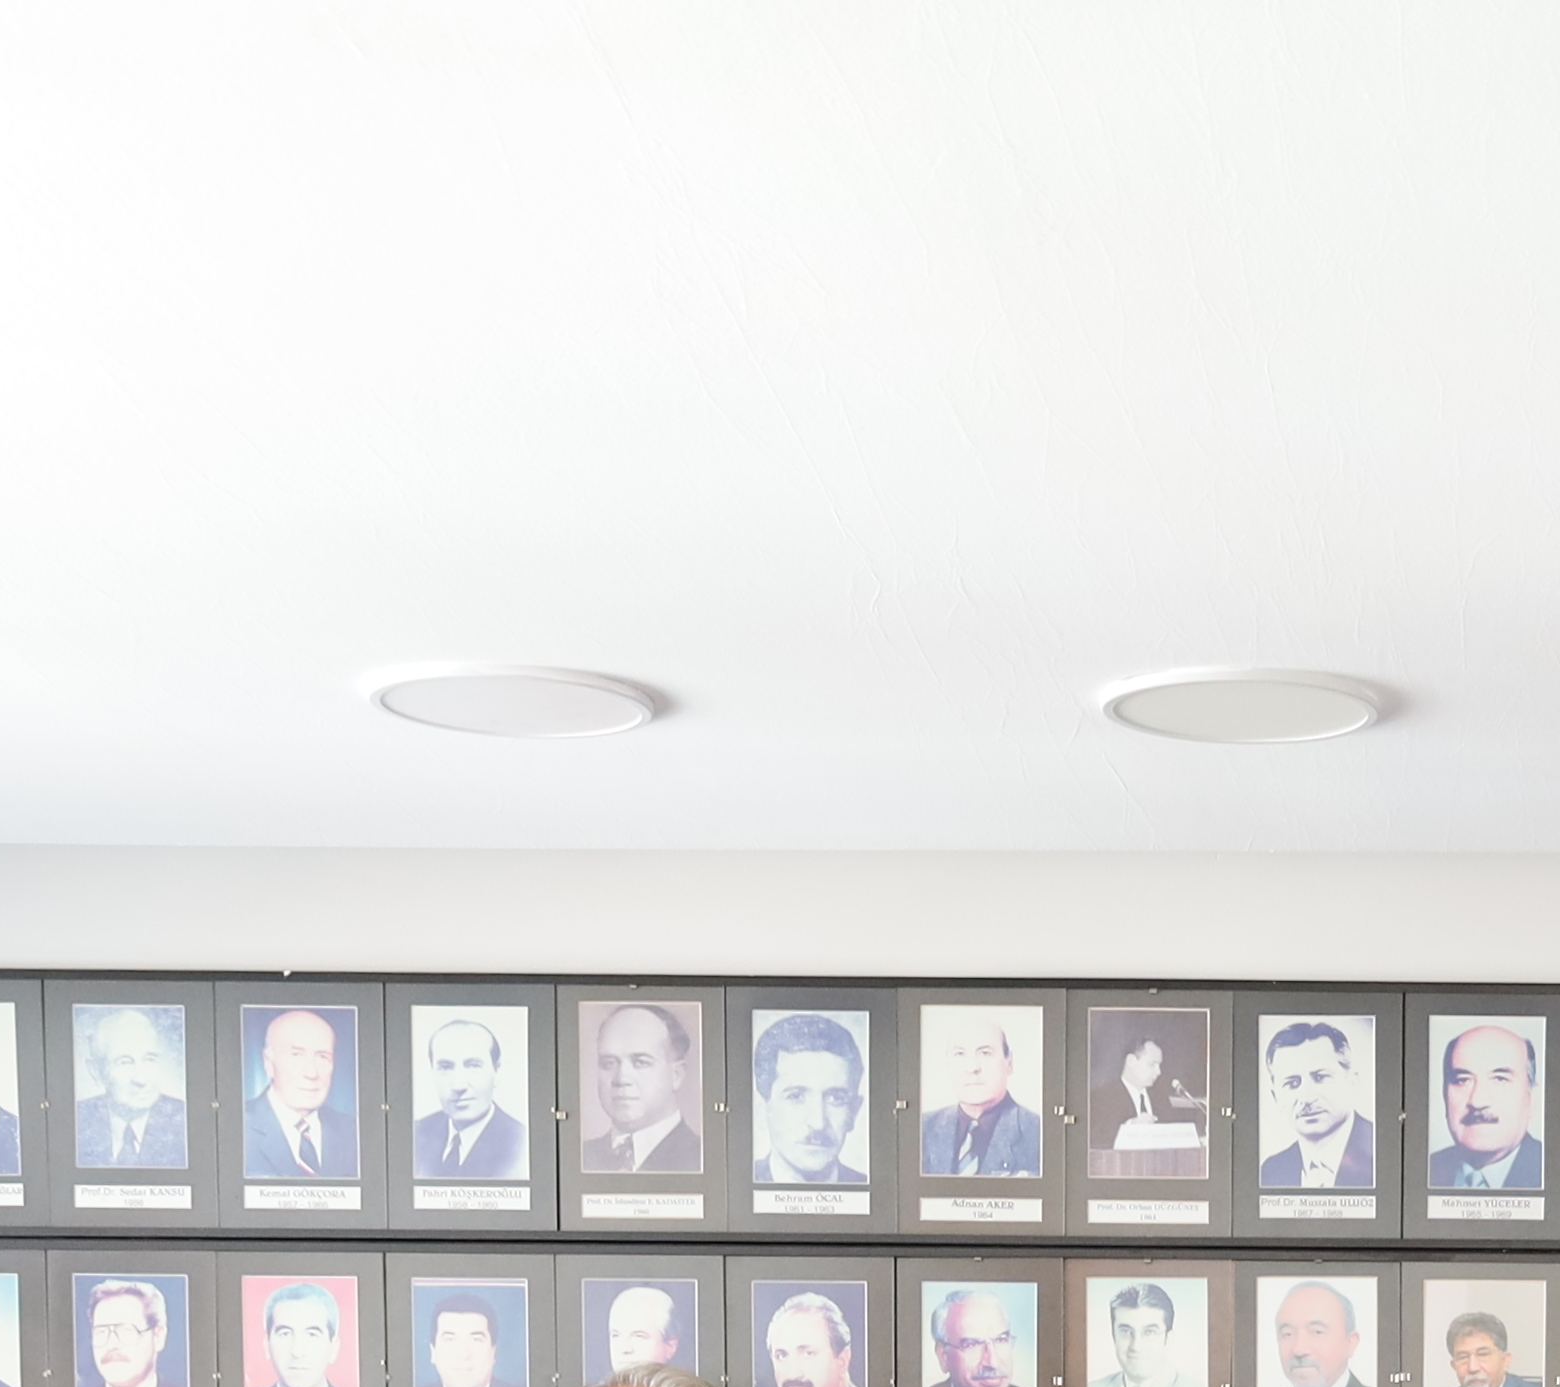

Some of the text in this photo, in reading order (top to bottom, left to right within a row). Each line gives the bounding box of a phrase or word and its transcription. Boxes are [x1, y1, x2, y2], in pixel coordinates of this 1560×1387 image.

[293, 1189, 346, 1199] GÖKÇORA
[423, 1187, 522, 1200] Fahri KÖŞKEROĞLU
[774, 1192, 843, 1203] Behram ÖCAL
[952, 1199, 1014, 1210] Adnan AKER
[1300, 1198, 1337, 1207] Mustafa
[1442, 1197, 1530, 1208] Mehmet YÜCELER
